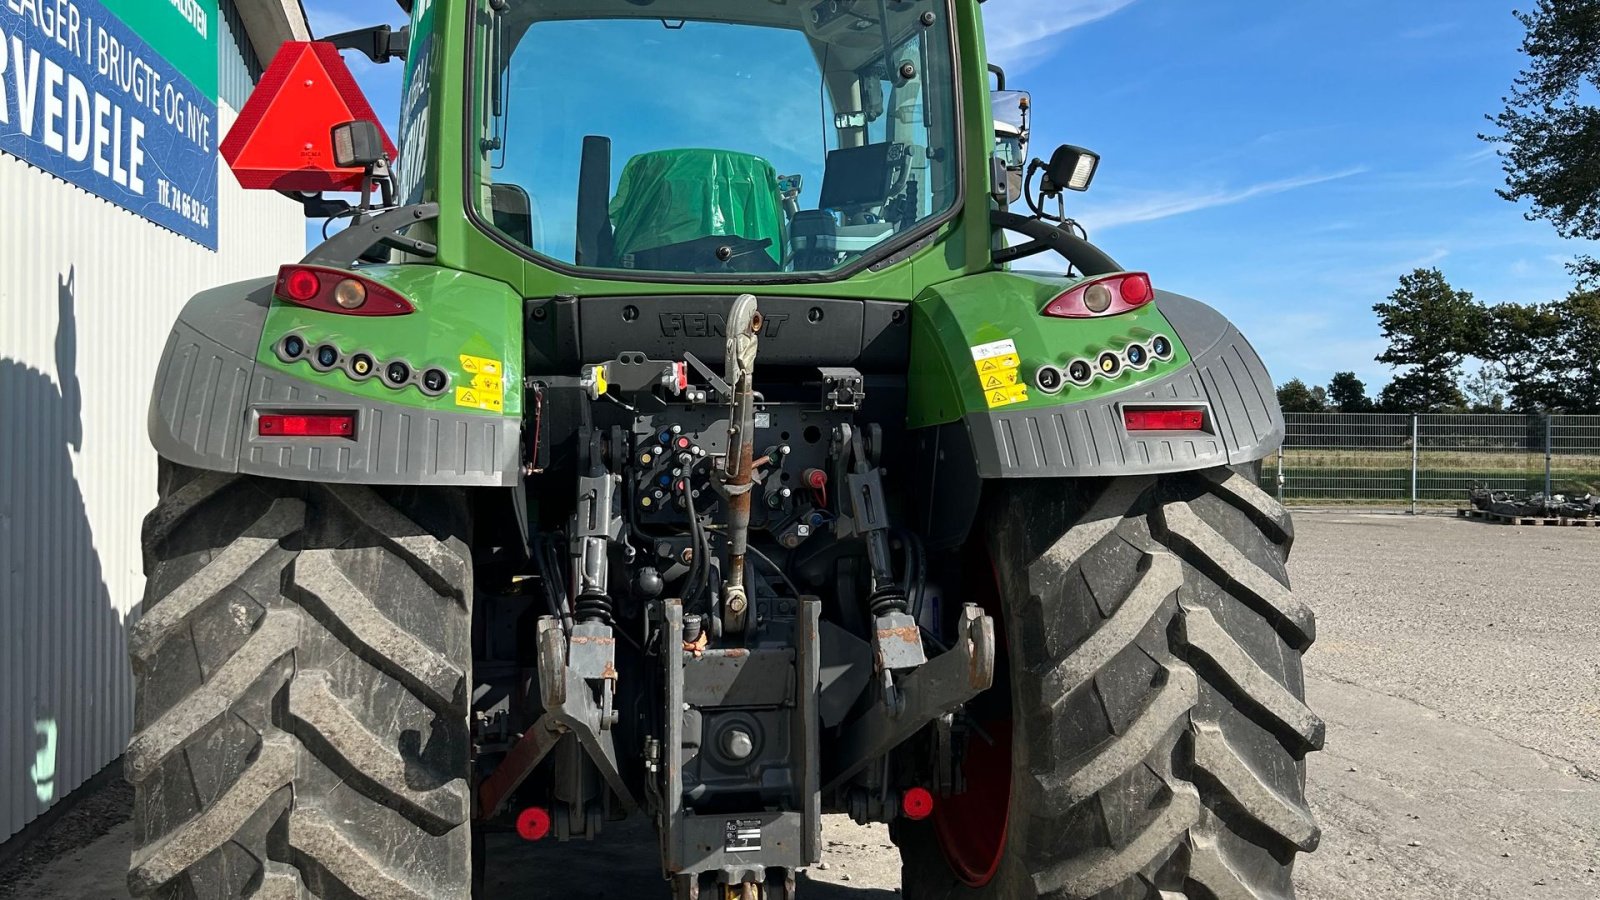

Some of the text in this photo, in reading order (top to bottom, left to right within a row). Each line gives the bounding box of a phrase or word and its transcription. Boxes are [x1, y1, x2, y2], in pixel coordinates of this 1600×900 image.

[87, 17, 92, 65] I
[98, 26, 160, 116] BRUGTE
[164, 83, 184, 133] OG
[187, 100, 209, 153] NYE
[157, 178, 209, 229] Tlf. 74 66 92 64
[659, 313, 789, 338] FENT
